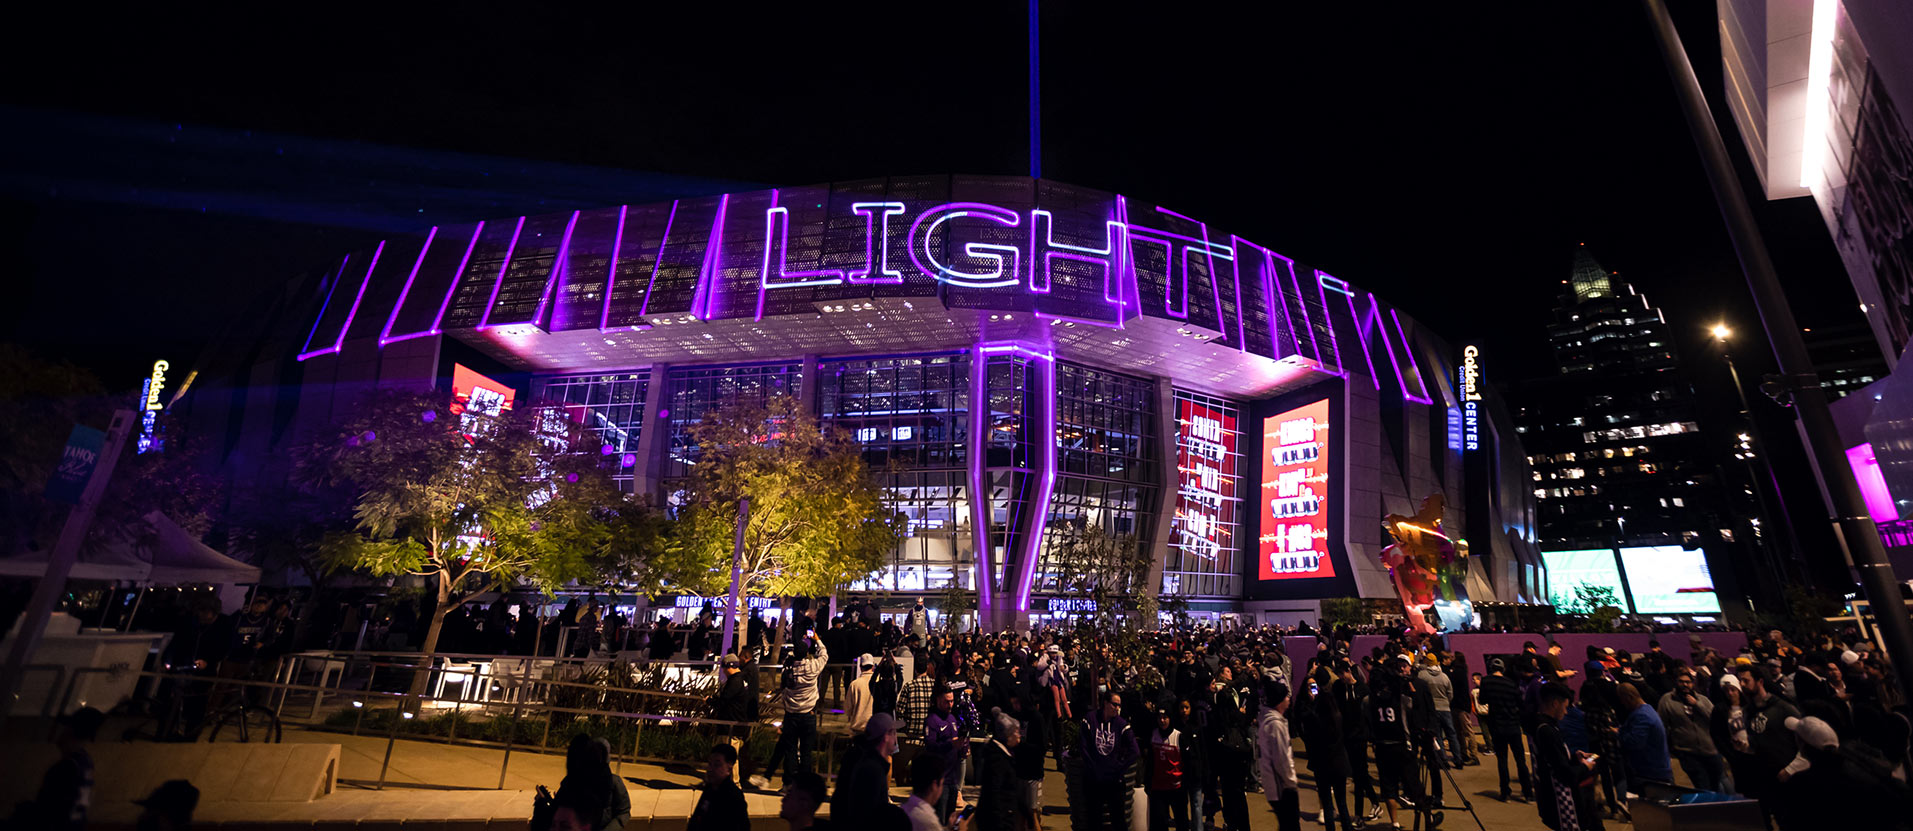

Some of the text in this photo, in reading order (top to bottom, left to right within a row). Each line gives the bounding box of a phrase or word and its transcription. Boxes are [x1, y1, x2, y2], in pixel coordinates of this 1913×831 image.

[762, 201, 1234, 318] LIGHT
[1465, 401, 1478, 450] CENTER
[676, 597, 703, 607] GOLDEN
[1377, 706, 1396, 722] 19
